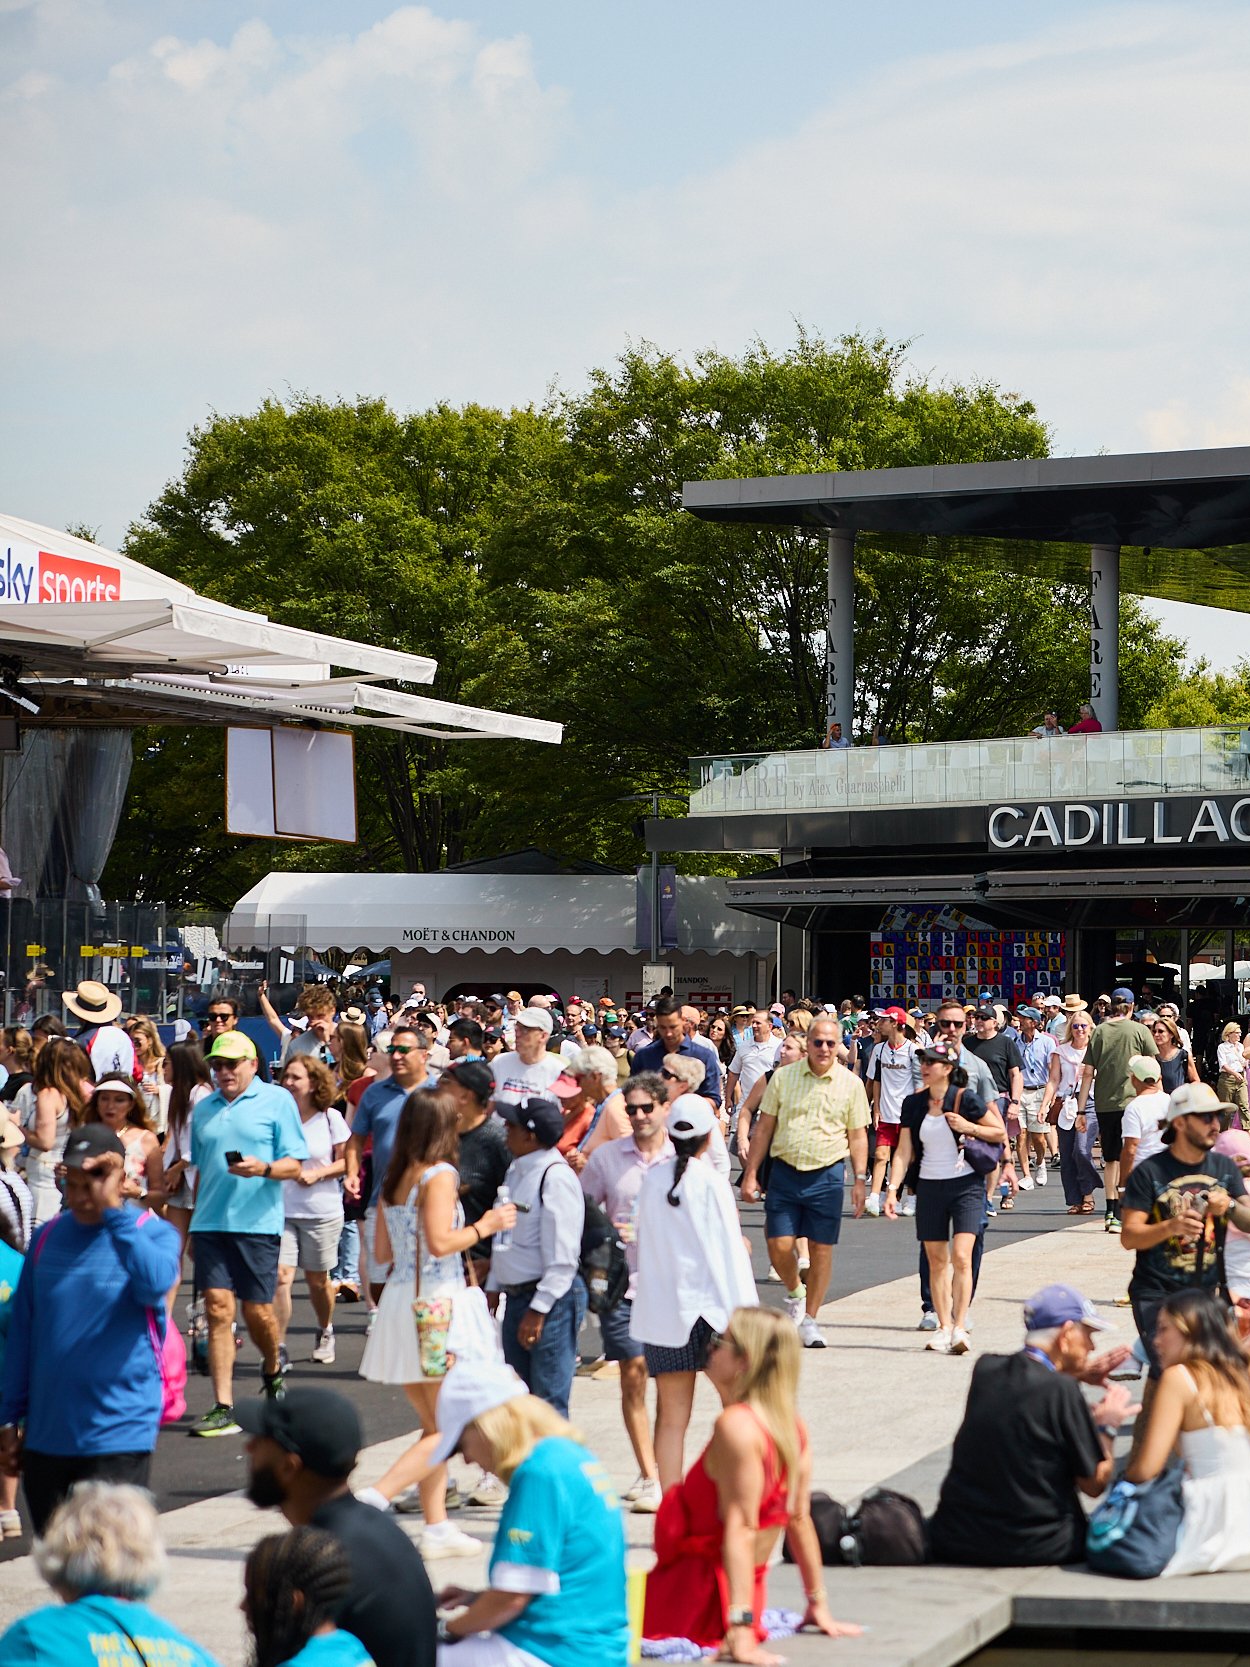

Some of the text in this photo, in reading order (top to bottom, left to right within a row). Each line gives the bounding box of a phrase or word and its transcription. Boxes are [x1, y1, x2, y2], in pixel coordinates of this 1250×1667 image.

[720, 763, 906, 801] FARE by Alex Guarnaschelli
[402, 927, 516, 942] MOËT & CHANDON
